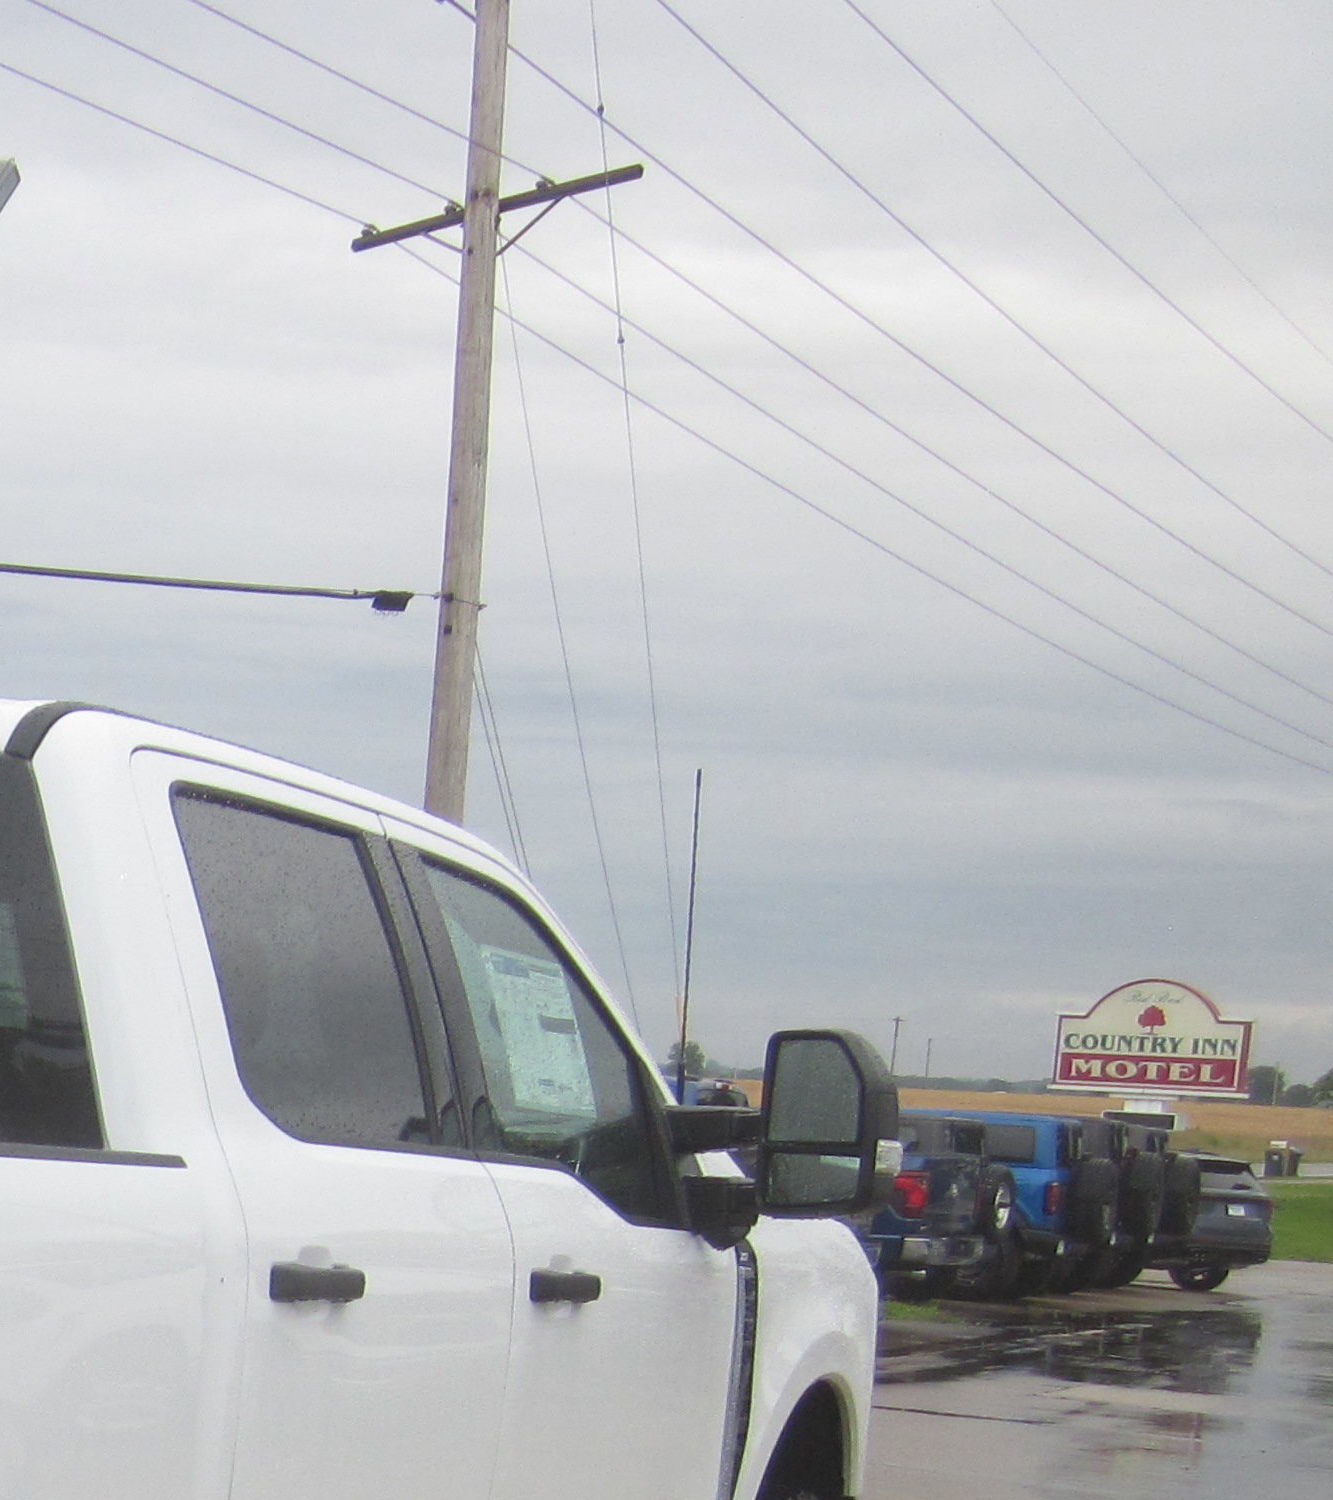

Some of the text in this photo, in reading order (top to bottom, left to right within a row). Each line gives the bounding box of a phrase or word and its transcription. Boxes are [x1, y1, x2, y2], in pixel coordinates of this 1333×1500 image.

[1063, 1032, 1238, 1056] COUNTRY INN
[1069, 1058, 1226, 1083] MOTEL
